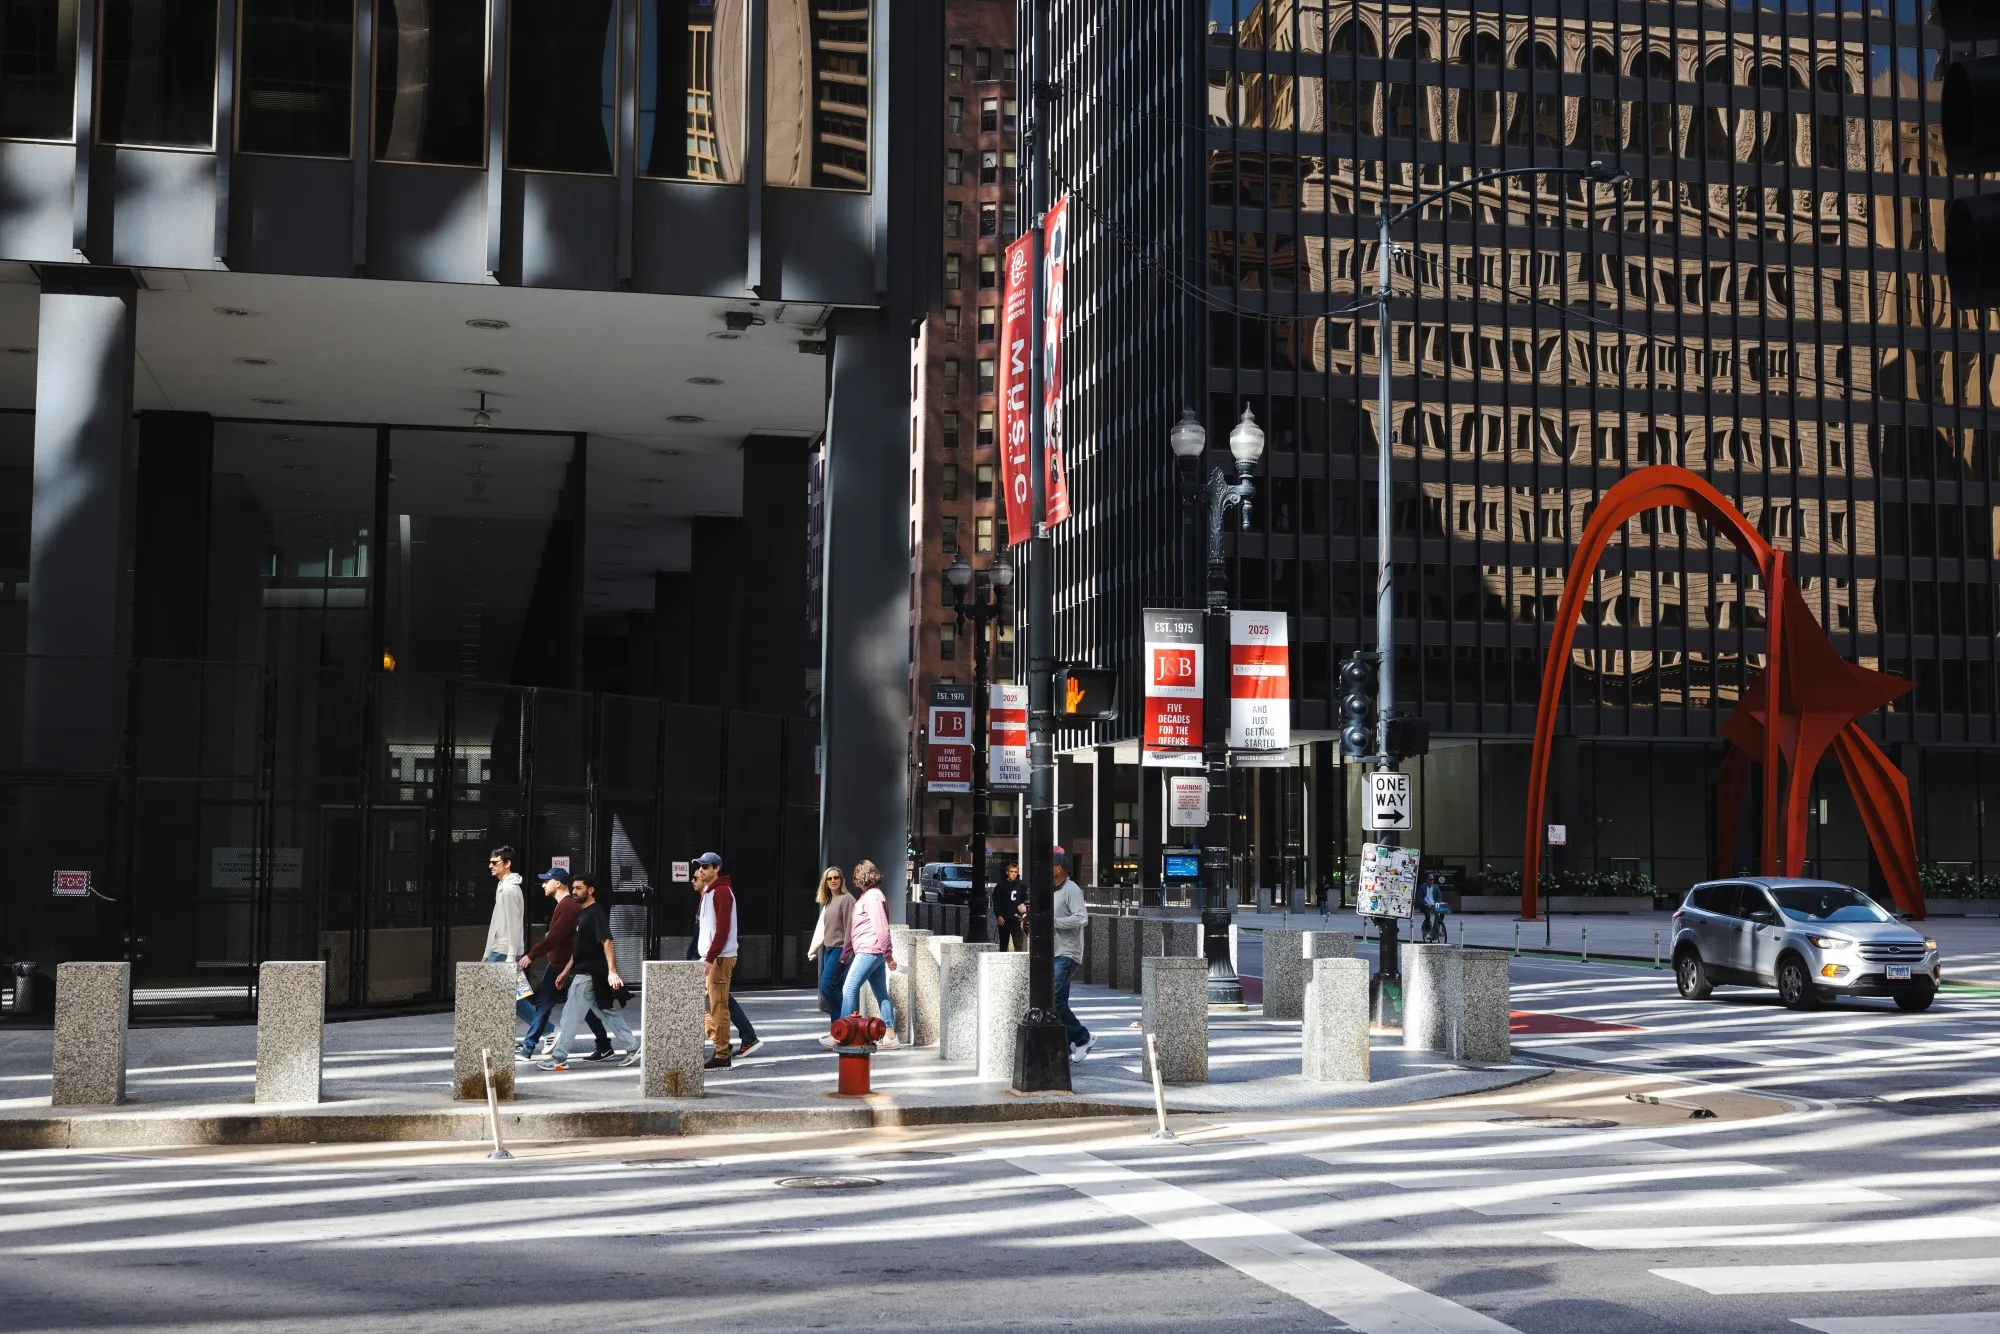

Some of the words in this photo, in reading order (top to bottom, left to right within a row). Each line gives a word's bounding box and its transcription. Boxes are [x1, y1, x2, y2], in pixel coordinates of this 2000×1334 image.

[1012, 338, 1027, 504] MUSIC
[1154, 622, 1172, 633] EST.
[1173, 622, 1194, 633] 1975
[1248, 624, 1269, 635] 2025
[1156, 656, 1192, 680] J&B
[937, 692, 949, 700] EST.
[951, 692, 965, 700] 1975
[1003, 694, 1018, 702] 2025
[1167, 703, 1183, 713] FIVE
[1252, 705, 1267, 714] AND
[1157, 714, 1191, 724] DECADES
[1251, 716, 1269, 725] JUST
[1158, 725, 1174, 735] FOR
[1175, 726, 1189, 735] THE
[1245, 727, 1275, 736] GETTING
[1244, 738, 1276, 748] STARTED
[1004, 749, 1016, 757] AND
[937, 755, 962, 763] DECADES
[950, 763, 961, 771] THE
[1376, 777, 1406, 791] ONE
[1375, 793, 1407, 807] WAY
[552, 859, 569, 867] ENTRANCE
[673, 864, 688, 872] ENTRANCE
[1010, 890, 1017, 901] C
